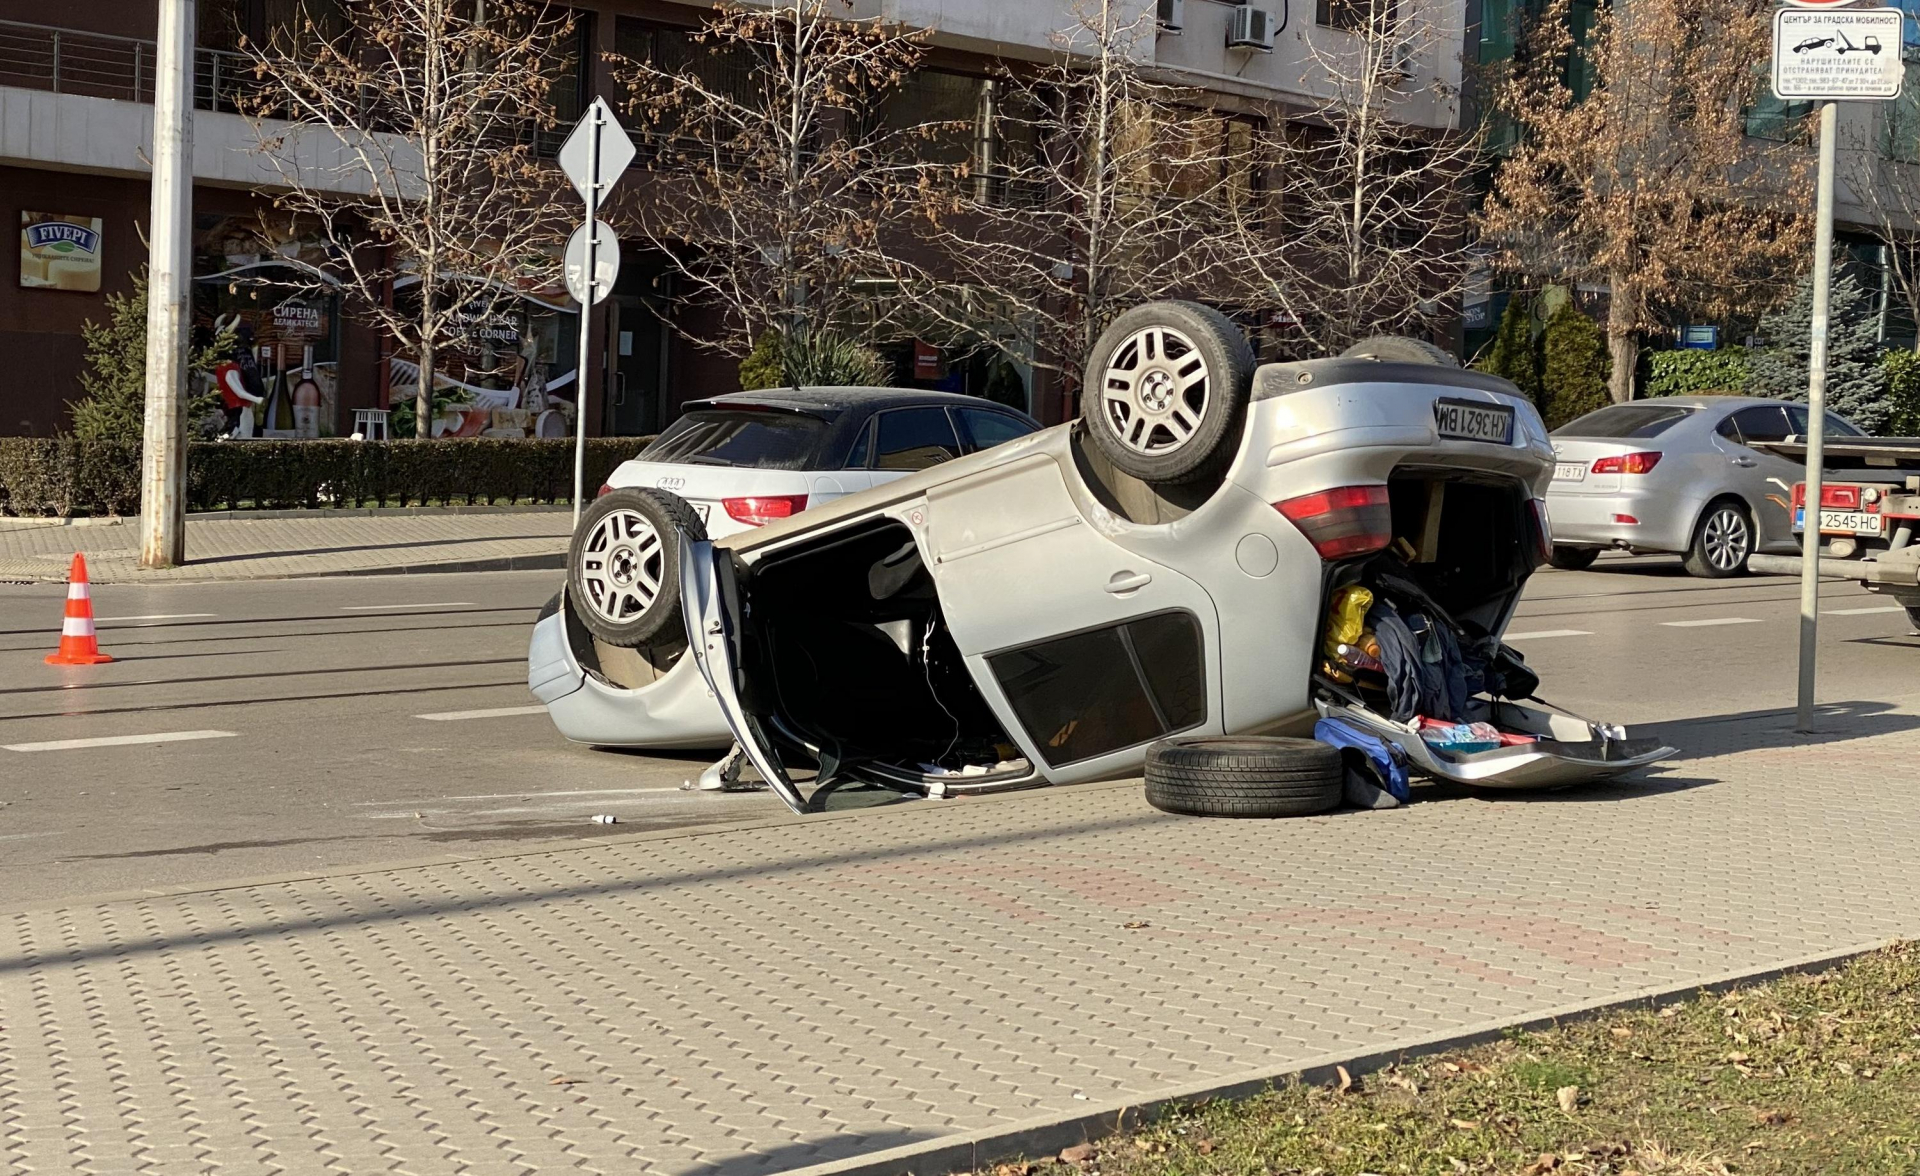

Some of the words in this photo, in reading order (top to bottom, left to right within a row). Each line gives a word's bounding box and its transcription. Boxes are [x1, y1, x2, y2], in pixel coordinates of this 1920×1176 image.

[1784, 15, 1811, 24] ЦЕНТЪР
[1813, 15, 1822, 24] ЗА
[1824, 15, 1854, 24] ГРАДСКА
[1855, 15, 1897, 25] МОБИЛНОСТ
[1800, 58, 1861, 66] НАРУШИТЕЛИТЕ
[1865, 58, 1875, 66] СЕ
[1783, 67, 1833, 75] ОТСТРАНЯВАТ
[1836, 67, 1885, 75] ПРИНУДИТЕЛ
[38, 226, 88, 244] FIVEPI
[273, 306, 318, 319] СИРЕНА
[1466, 312, 1485, 323] STOP
[273, 317, 319, 328] ДЕЛИКАТЕСИ
[480, 329, 517, 340] CORNER
